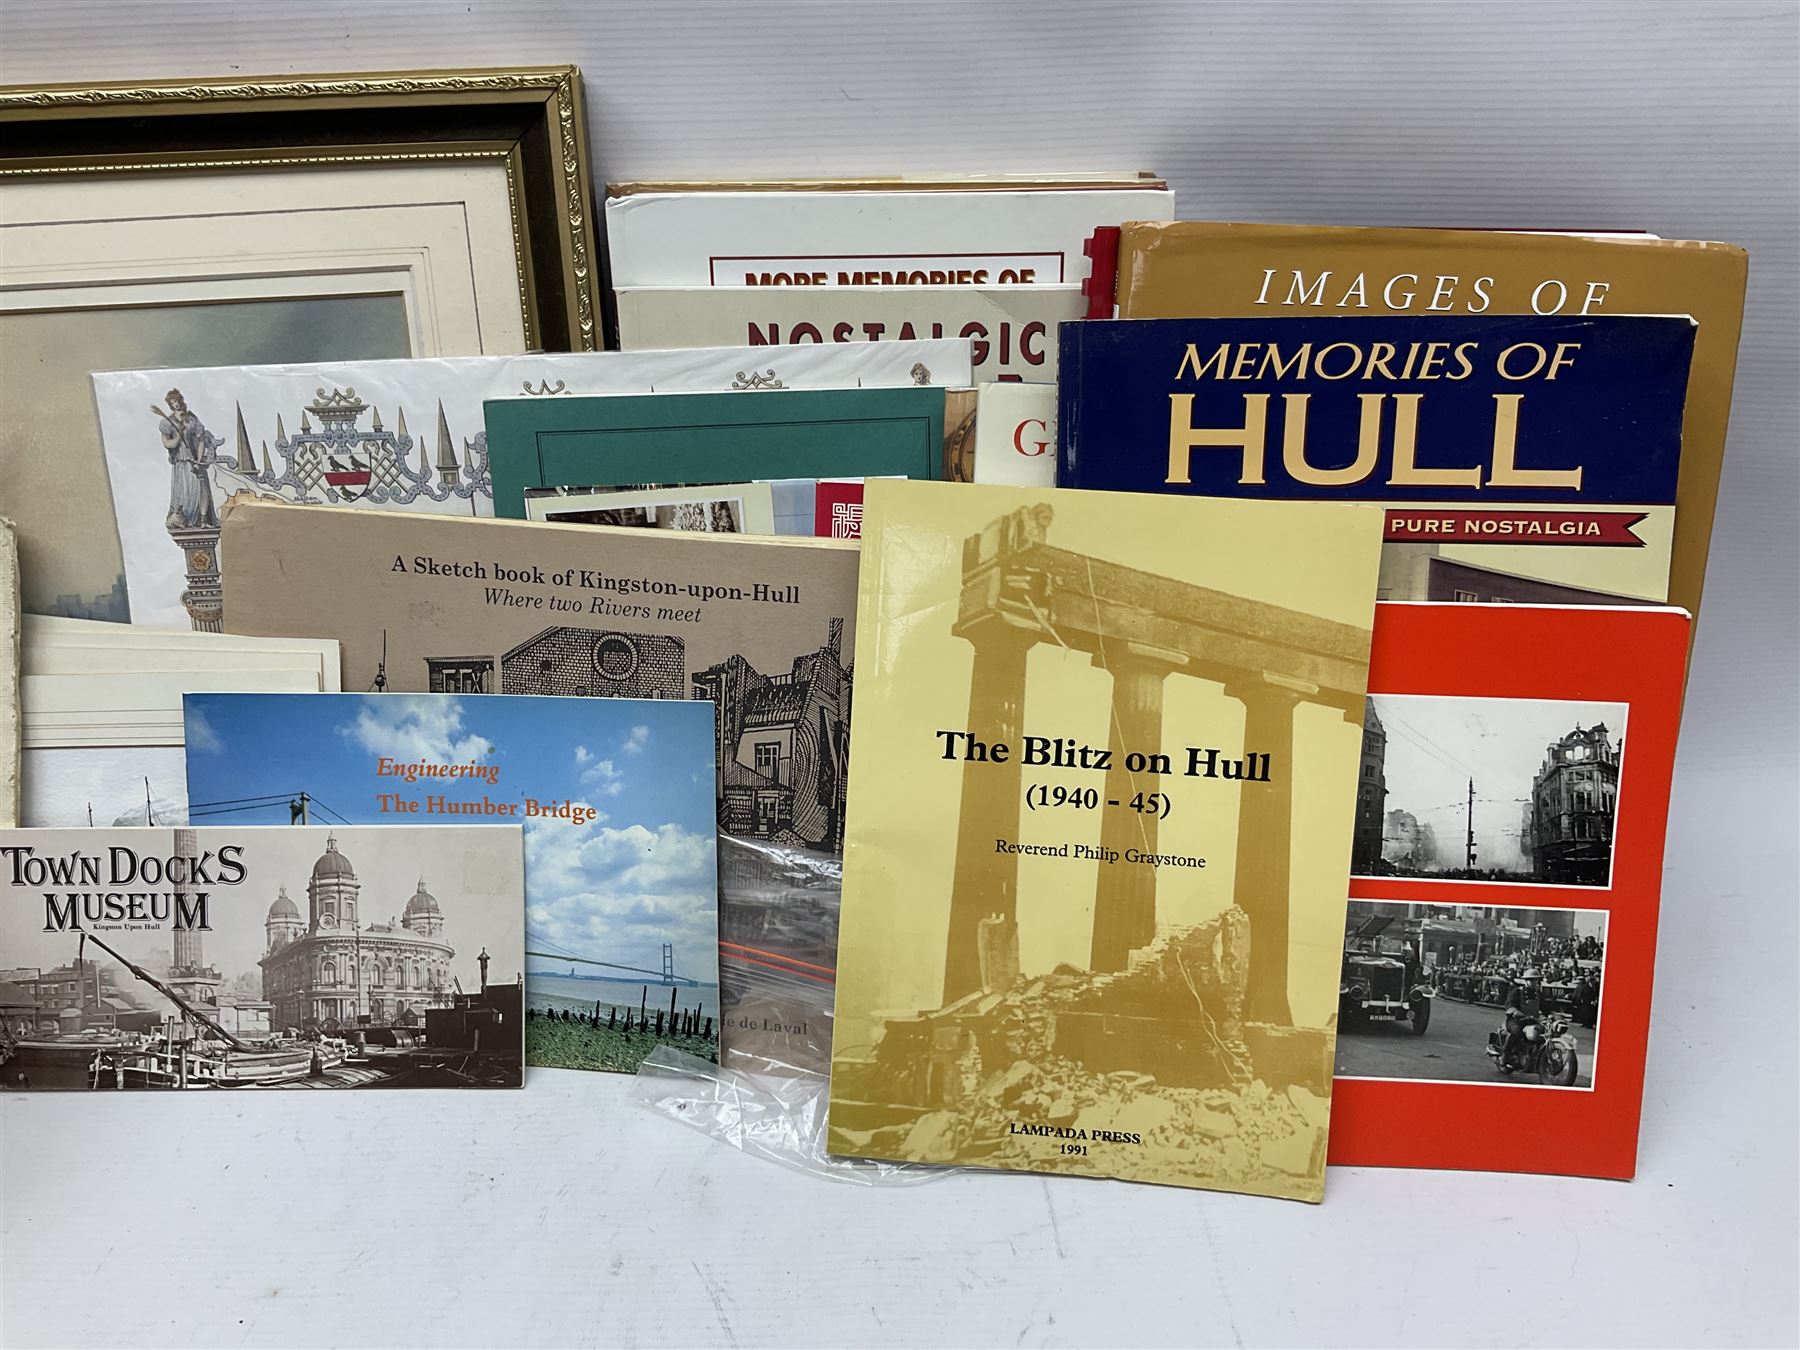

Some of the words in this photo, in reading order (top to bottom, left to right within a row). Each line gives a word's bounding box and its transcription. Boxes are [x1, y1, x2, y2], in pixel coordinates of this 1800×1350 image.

[1255, 269, 1494, 313] IMAGES
[1531, 280, 1610, 315] OF
[1175, 342, 1479, 381] MEMORIES
[1497, 342, 1582, 380] OF
[1164, 394, 1583, 491] HULL
[1391, 519, 1455, 534] PURE
[1464, 521, 1602, 536] NOSTALGIA
[391, 555, 407, 574] A
[413, 557, 487, 580] Sketch
[493, 563, 546, 585] book
[552, 569, 575, 587] of
[579, 571, 801, 604] Kingston-upon-Hull
[485, 588, 543, 609] Where
[549, 597, 582, 612] two
[590, 598, 651, 619] Rivers
[656, 606, 702, 623] meet
[376, 758, 500, 784] Engineering
[936, 730, 1009, 763] The
[1022, 736, 1112, 770] Blitz
[1125, 752, 1172, 774] on
[1184, 748, 1271, 782] Hull
[377, 794, 420, 813] The
[426, 797, 518, 817] Humber
[524, 800, 597, 825] Bridge
[1026, 784, 1098, 811] (1940
[1129, 792, 1172, 820] 45)
[0, 847, 101, 886] TOWN
[108, 846, 248, 886] DOCKS
[995, 839, 1069, 858] Reverend
[1074, 845, 1119, 864] Philip
[1126, 848, 1206, 869] Graystone
[42, 892, 213, 932] MUSEUM
[124, 923, 142, 931] Upon
[739, 1016, 758, 1030] de
[762, 1018, 808, 1035] Laval
[1010, 1123, 1088, 1140] LAMPADA
[1091, 1130, 1141, 1144] PRESS
[1060, 1144, 1088, 1156] 1991
